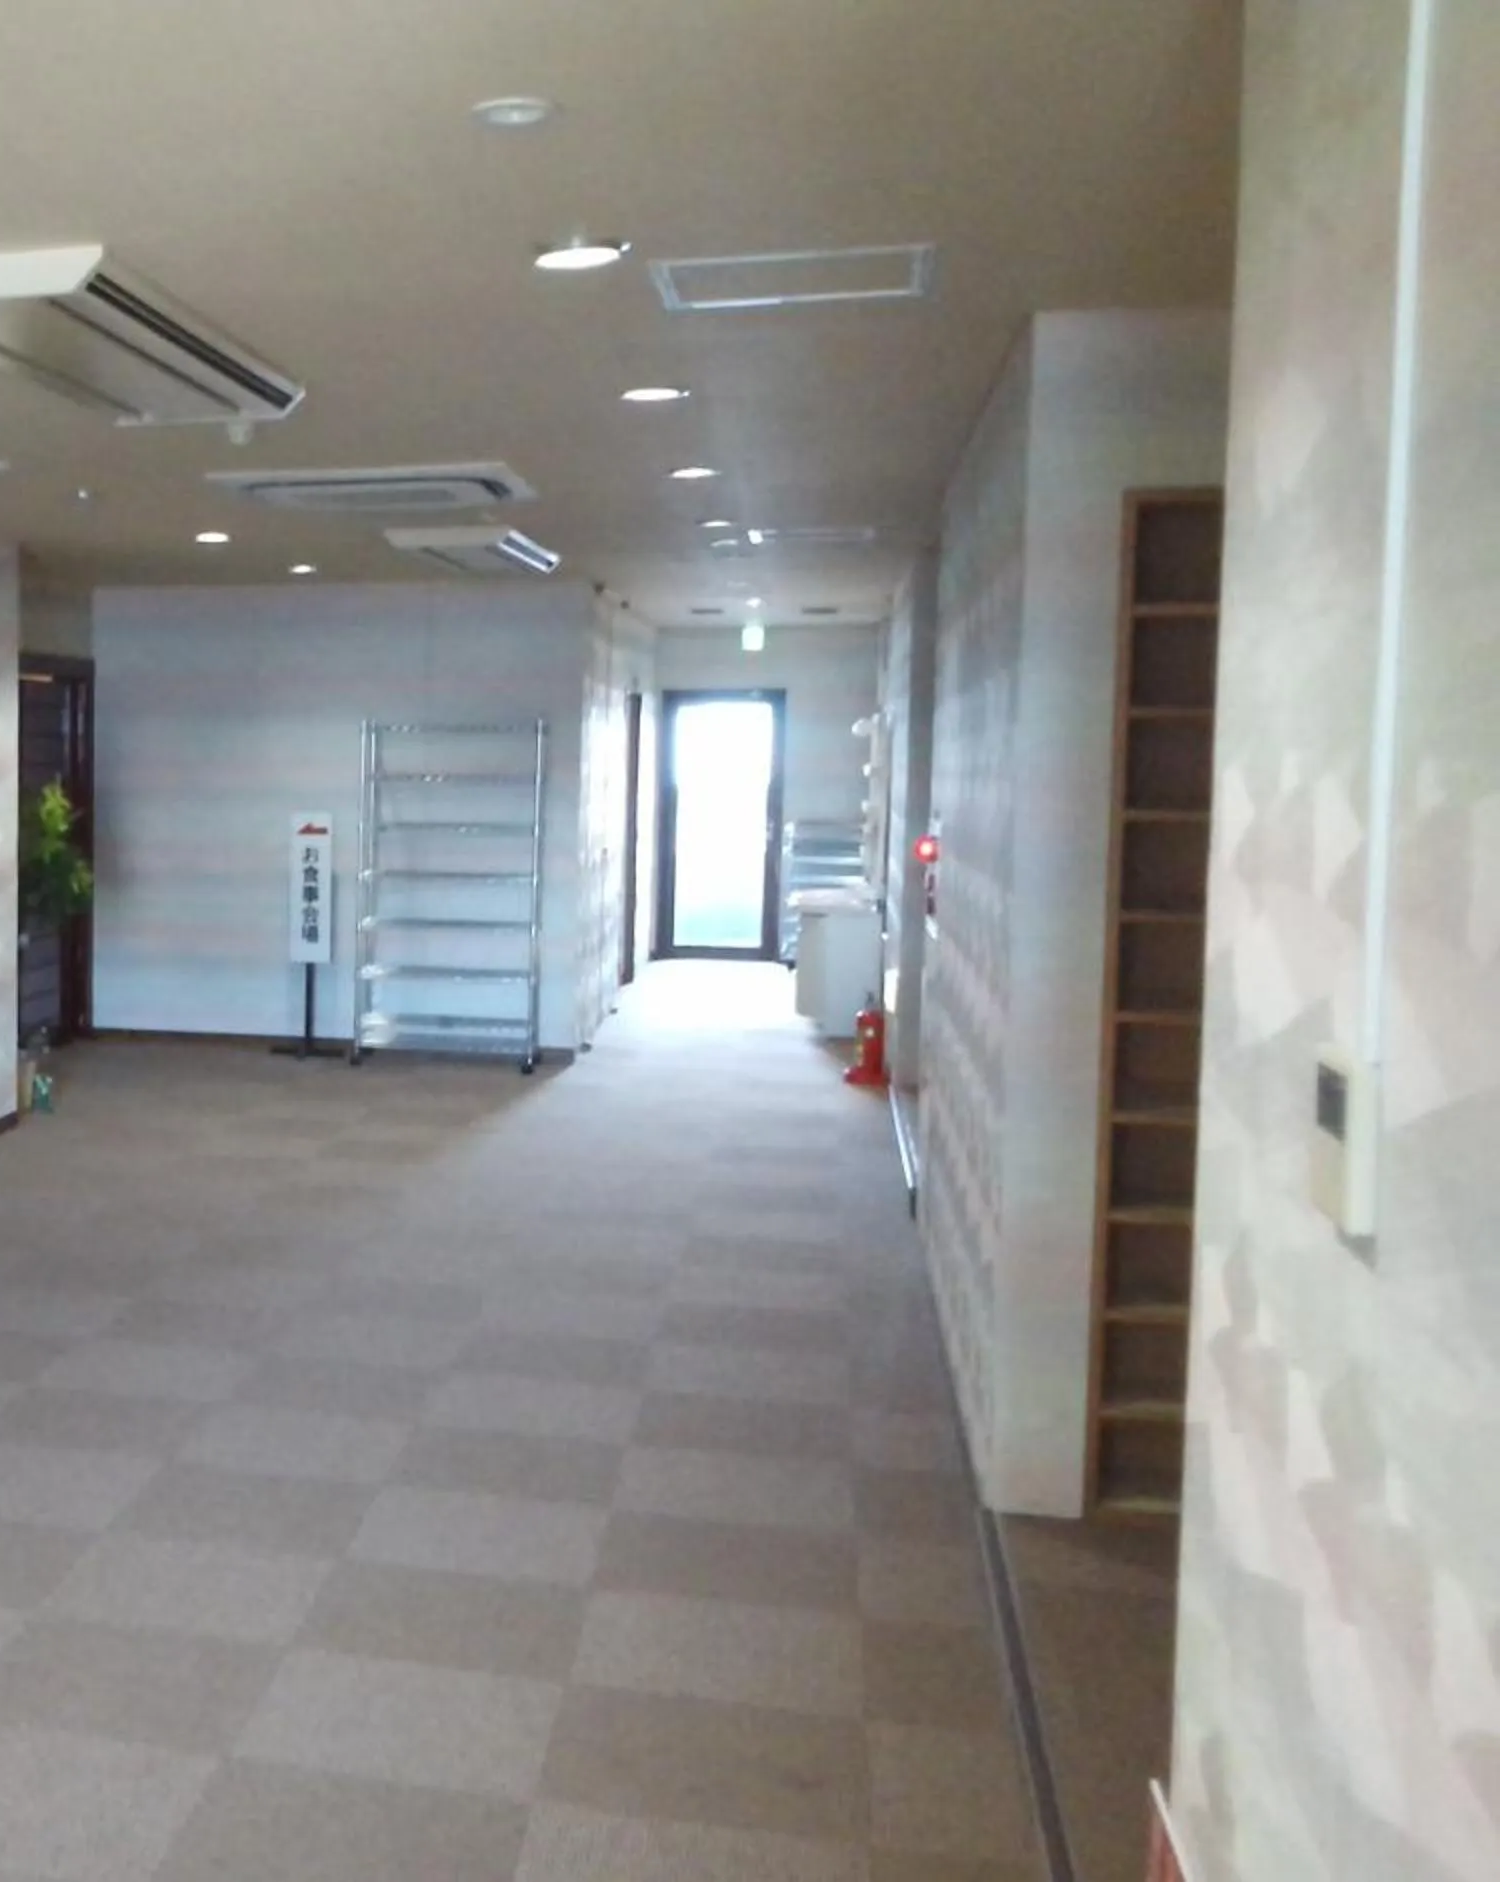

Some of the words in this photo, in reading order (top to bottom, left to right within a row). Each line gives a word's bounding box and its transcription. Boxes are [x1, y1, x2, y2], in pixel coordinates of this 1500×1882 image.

[301, 847, 320, 943] お食事会場
